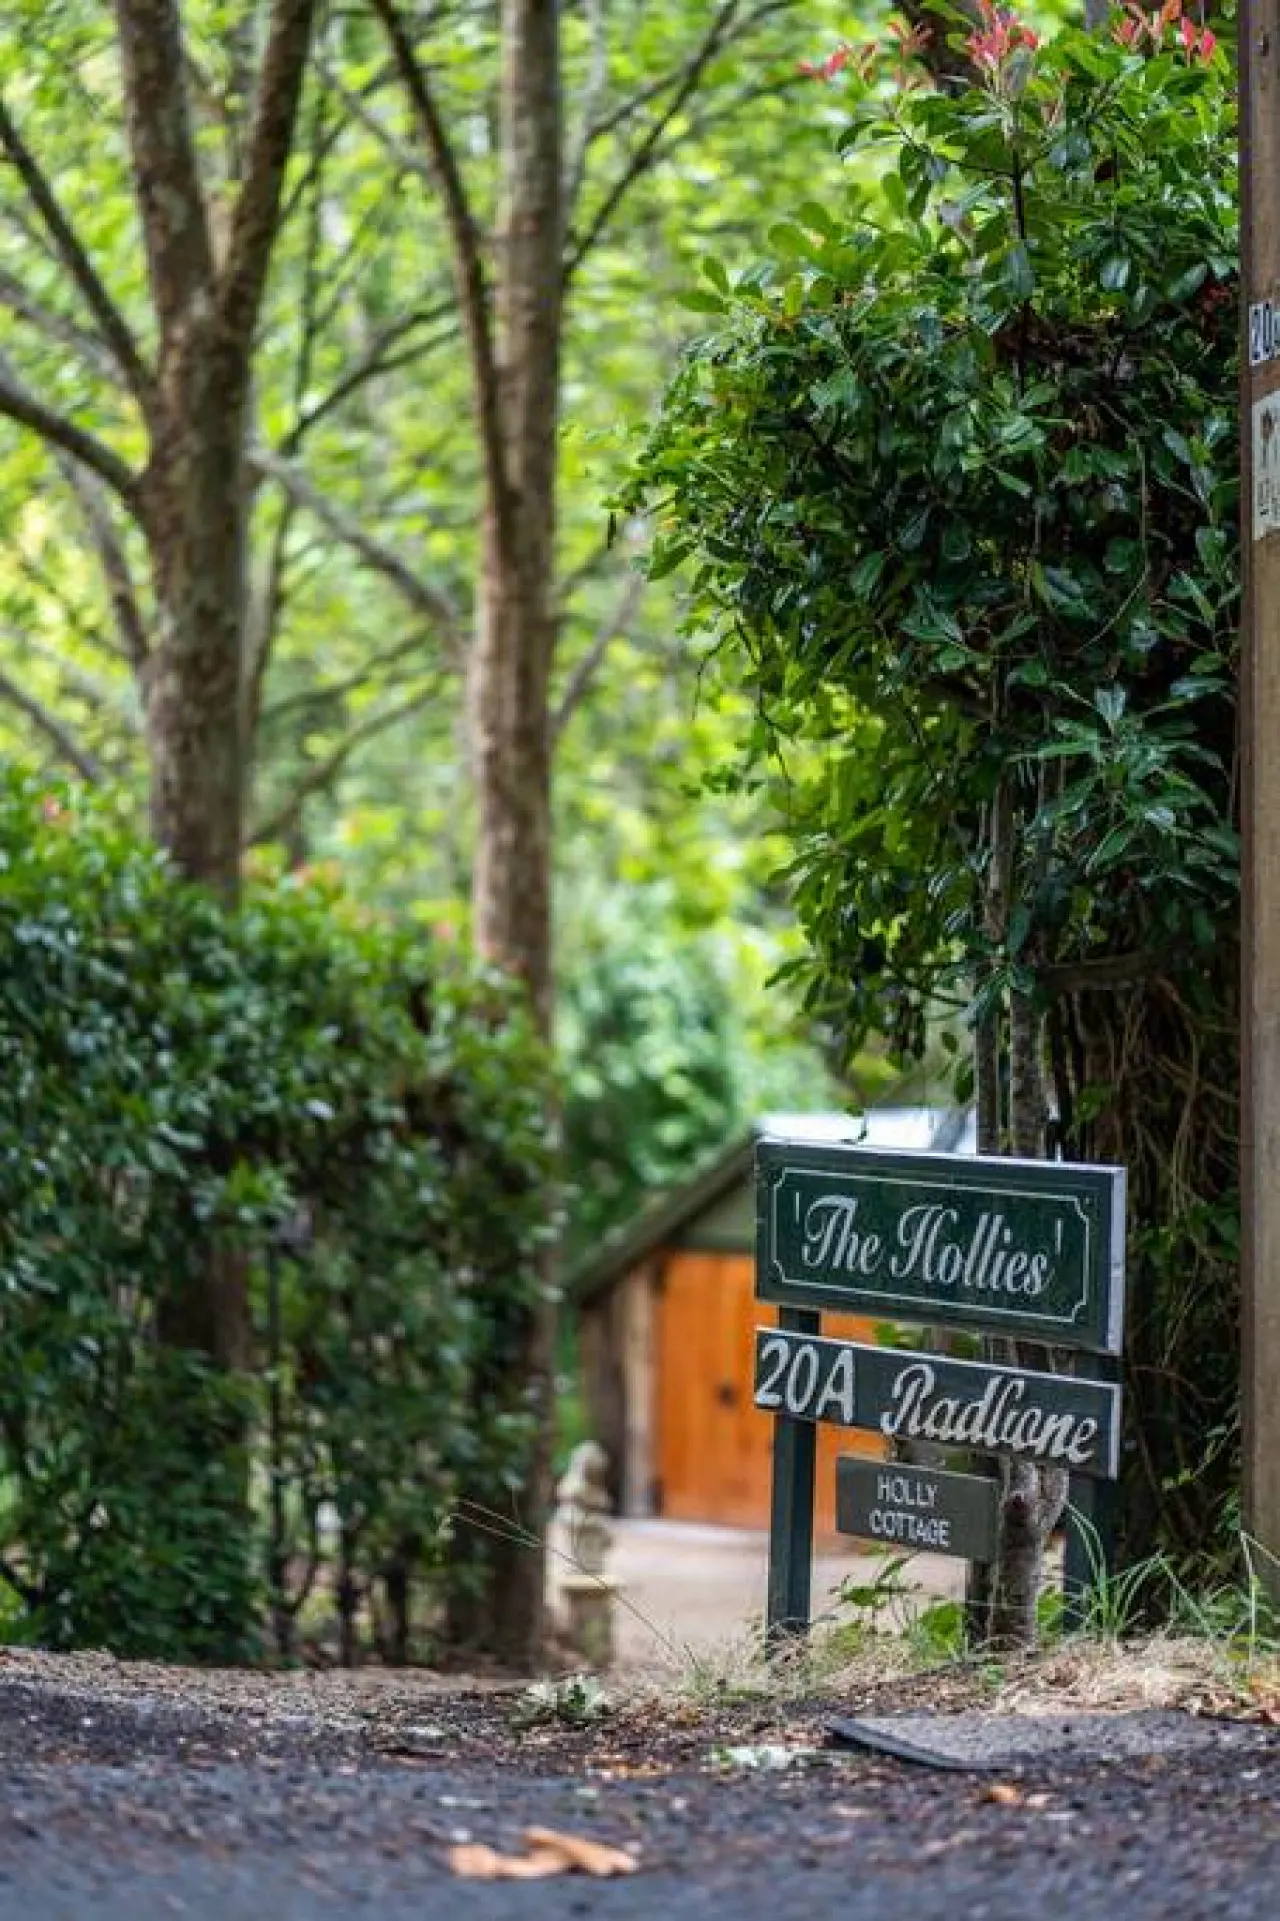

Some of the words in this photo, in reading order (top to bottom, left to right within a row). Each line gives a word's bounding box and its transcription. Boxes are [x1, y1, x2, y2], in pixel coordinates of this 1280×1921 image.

[755, 1338, 853, 1423] 20A
[877, 1474, 938, 1508] HOLLY
[868, 1507, 951, 1548] COTTAGE
